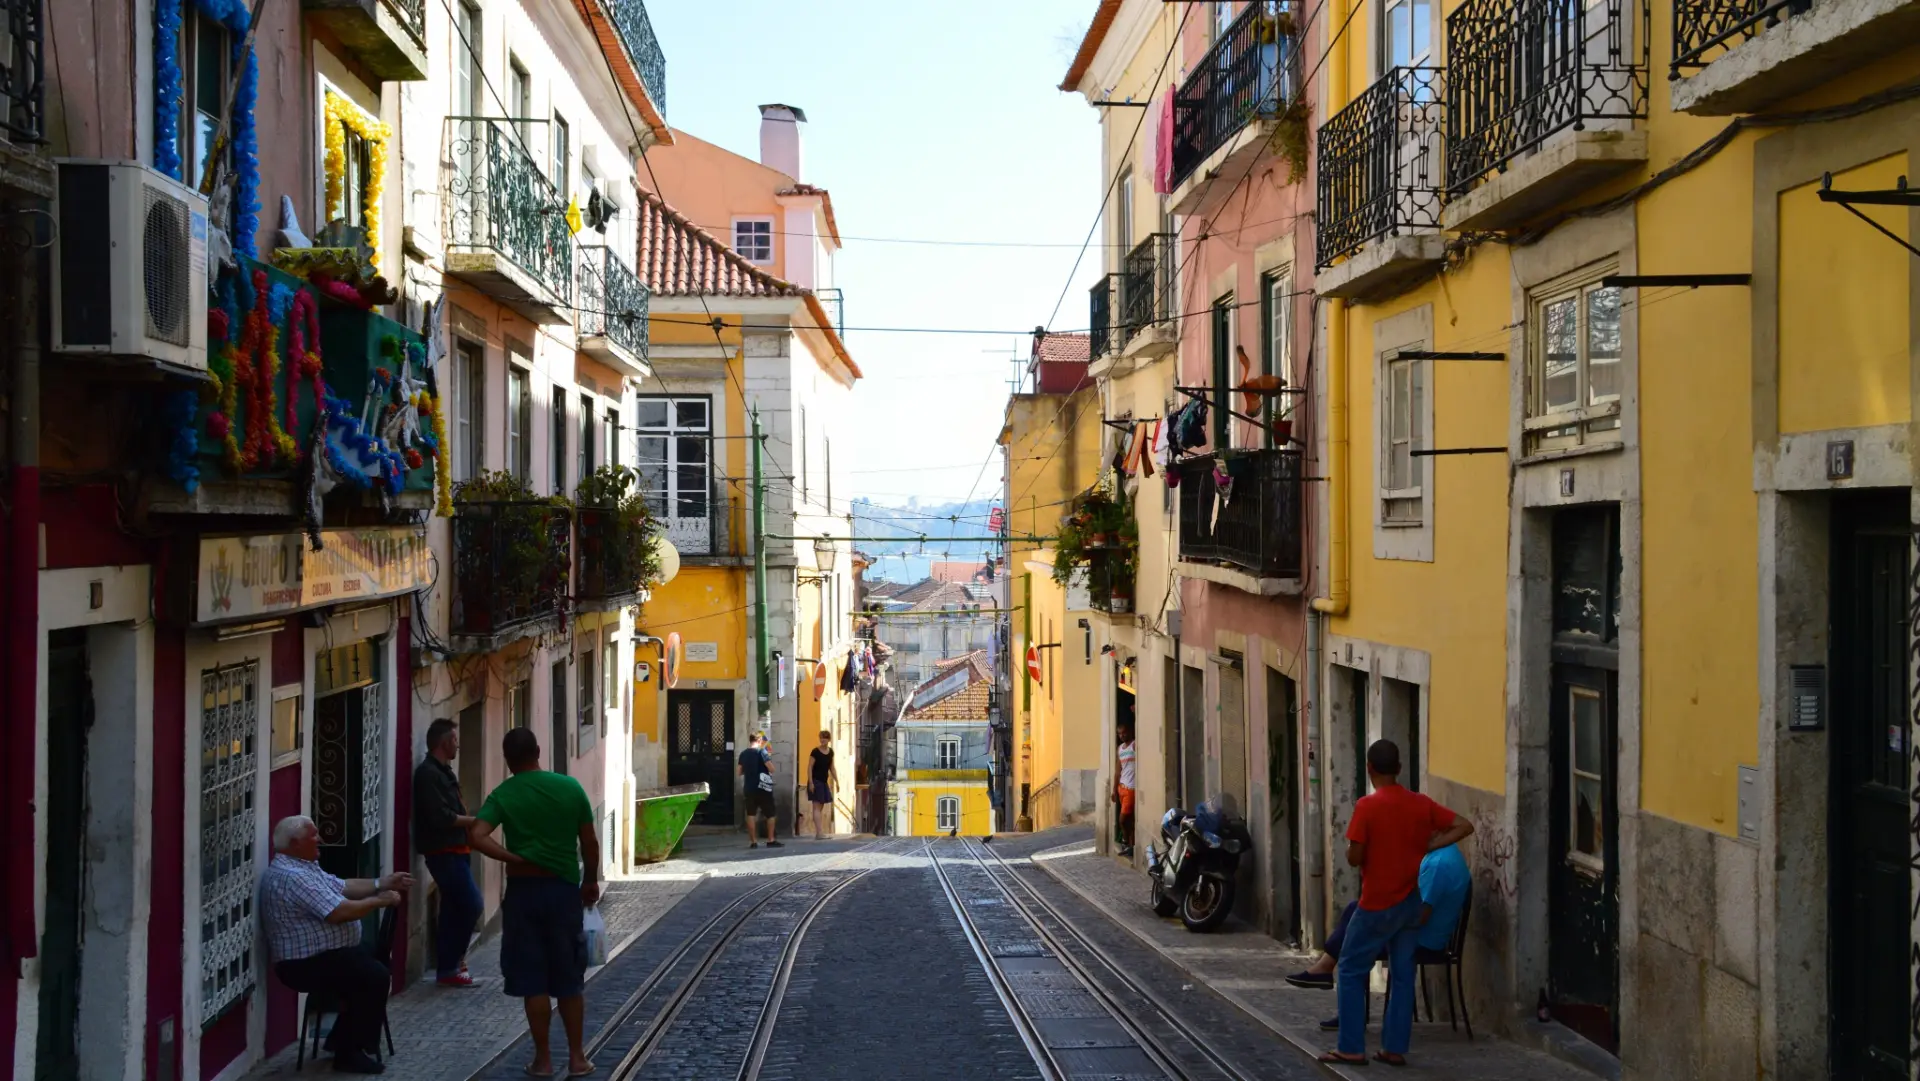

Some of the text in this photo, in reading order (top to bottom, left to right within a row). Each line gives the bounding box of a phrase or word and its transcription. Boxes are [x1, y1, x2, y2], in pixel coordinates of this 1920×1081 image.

[1831, 445, 1845, 474] 15
[242, 544, 288, 588] GRUPO
[312, 582, 332, 597] CULTURA
